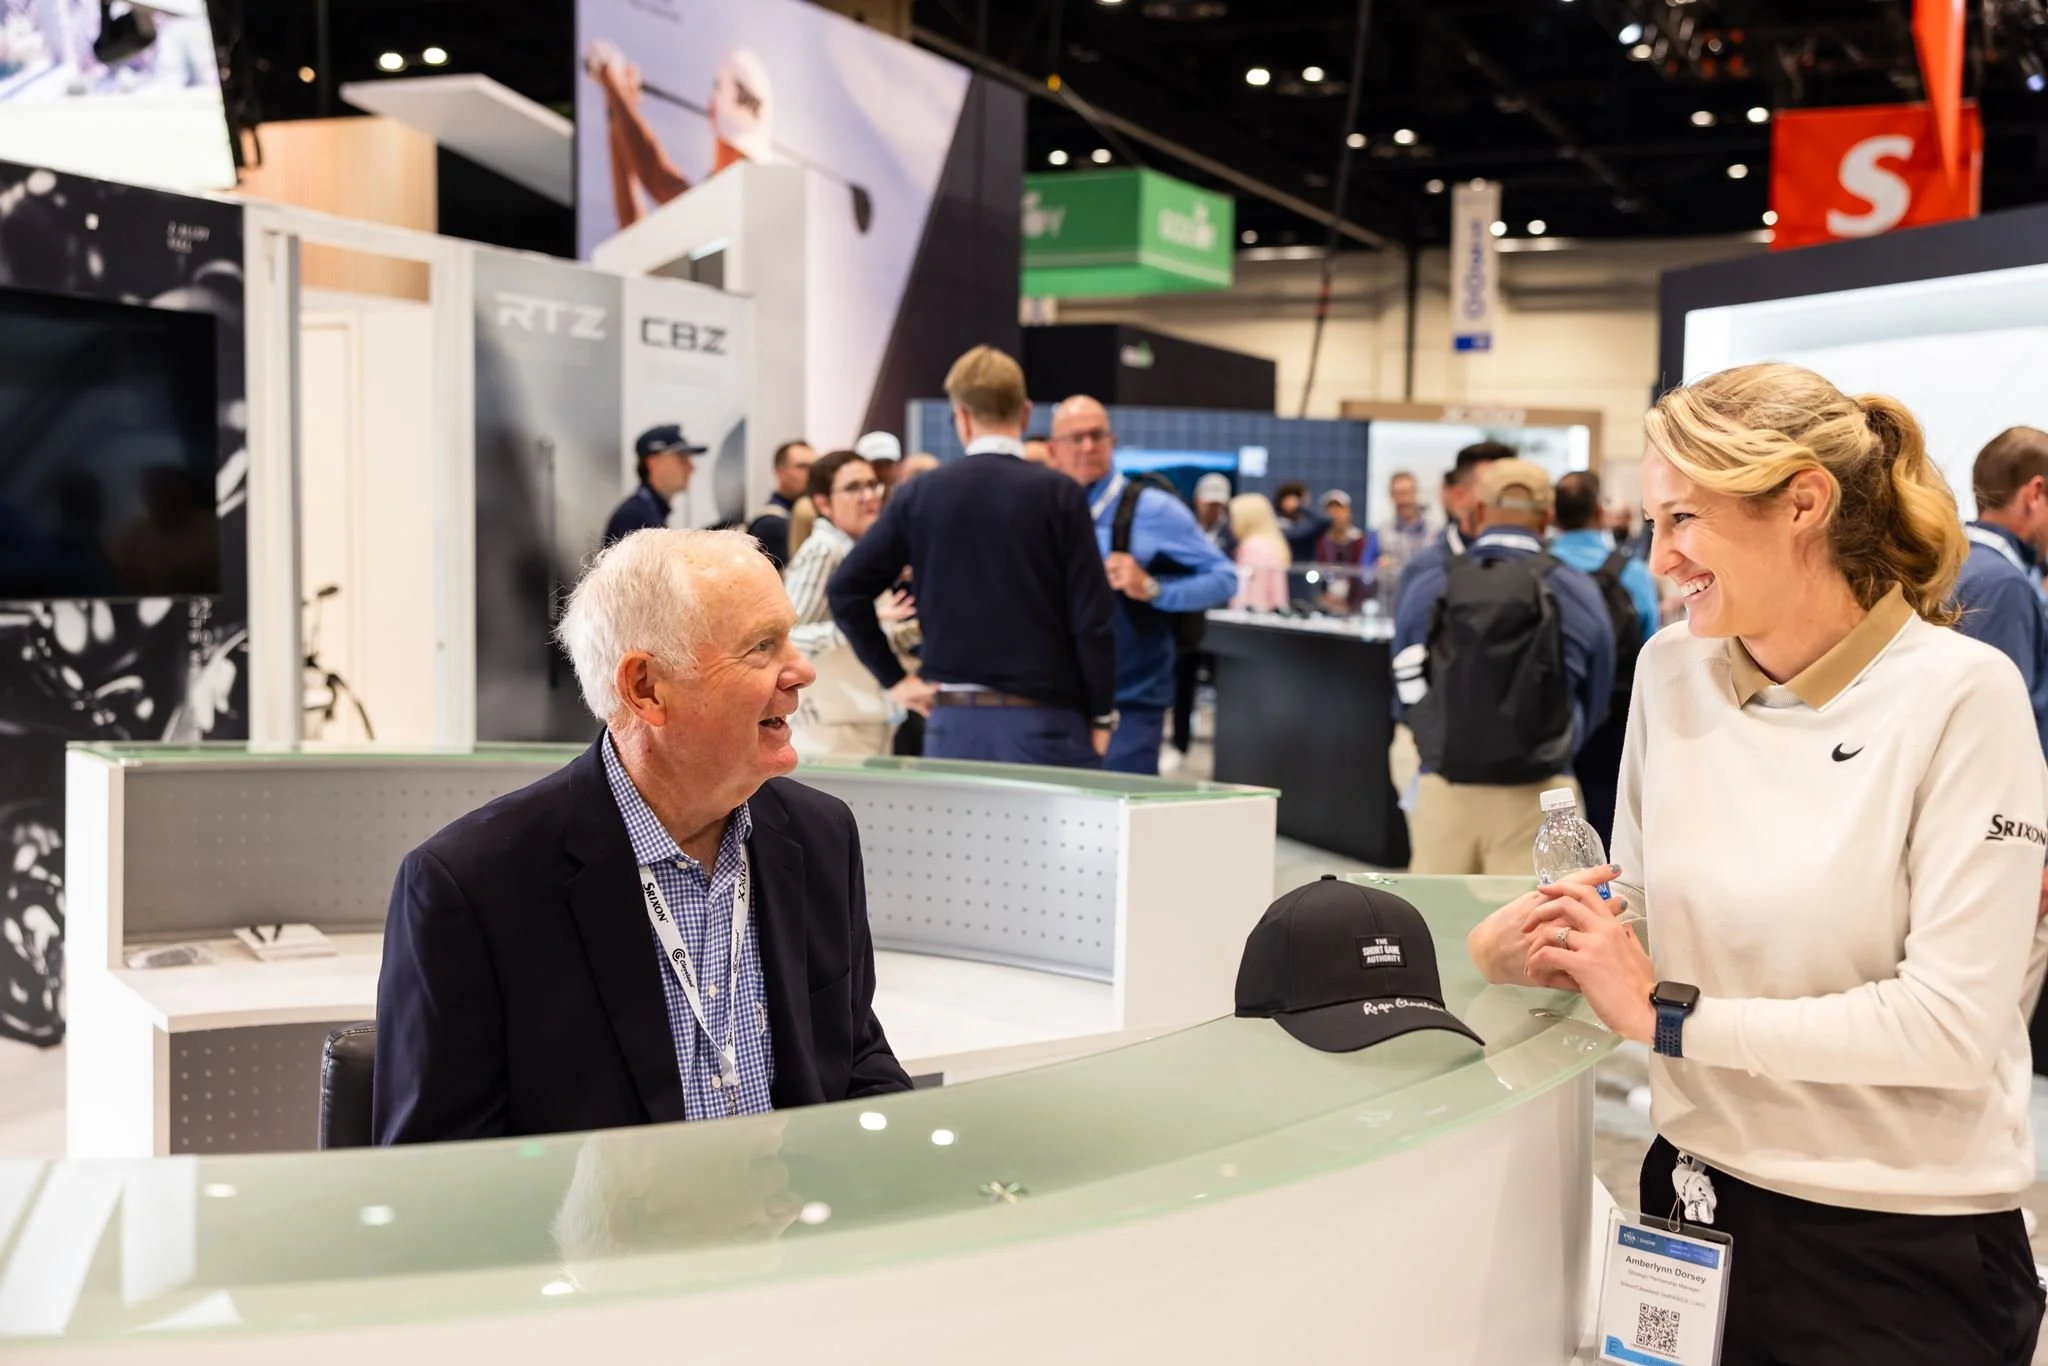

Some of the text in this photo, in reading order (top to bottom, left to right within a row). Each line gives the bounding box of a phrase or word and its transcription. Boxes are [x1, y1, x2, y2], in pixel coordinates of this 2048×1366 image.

[1826, 134, 1914, 238] S
[496, 292, 607, 342] RTZ
[641, 316, 728, 356] CBZ
[1985, 814, 2047, 847] SRIXON
[643, 882, 668, 922] SRIXON
[1362, 946, 1384, 956] SHORT
[1366, 955, 1401, 964] AUTHORITY
[1625, 1255, 1673, 1275] Amberlynn
[1674, 1268, 1706, 1285] Dorsey
